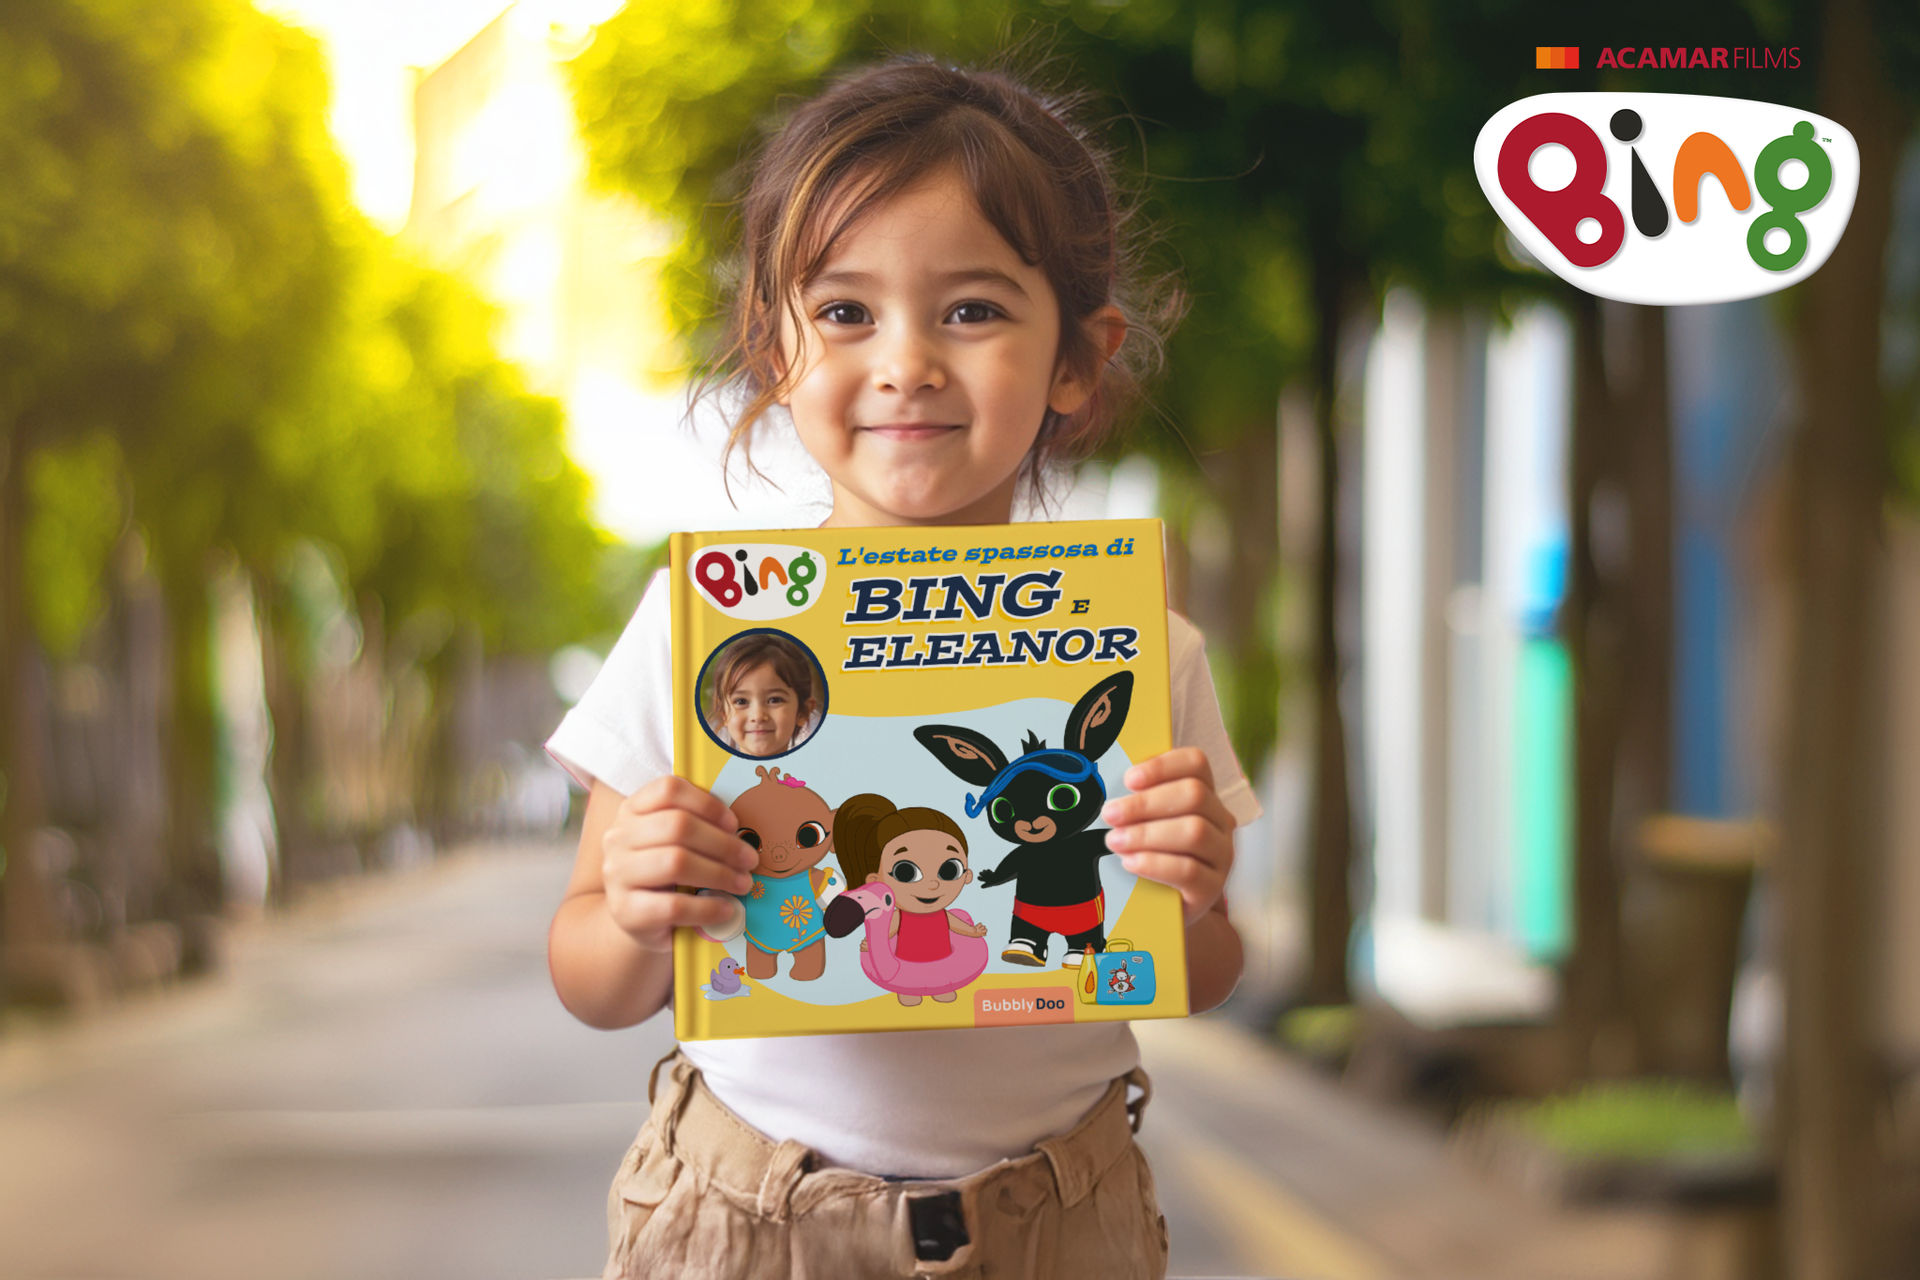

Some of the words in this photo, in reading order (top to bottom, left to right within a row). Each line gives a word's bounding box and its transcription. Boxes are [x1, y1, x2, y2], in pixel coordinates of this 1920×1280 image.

[837, 547, 958, 565] L'estate
[964, 543, 1099, 564] spassosa
[1106, 538, 1135, 556] di
[695, 549, 817, 607] Bing
[844, 568, 1064, 623] BING
[1070, 599, 1091, 615] E
[843, 626, 1139, 669] ELEANOR
